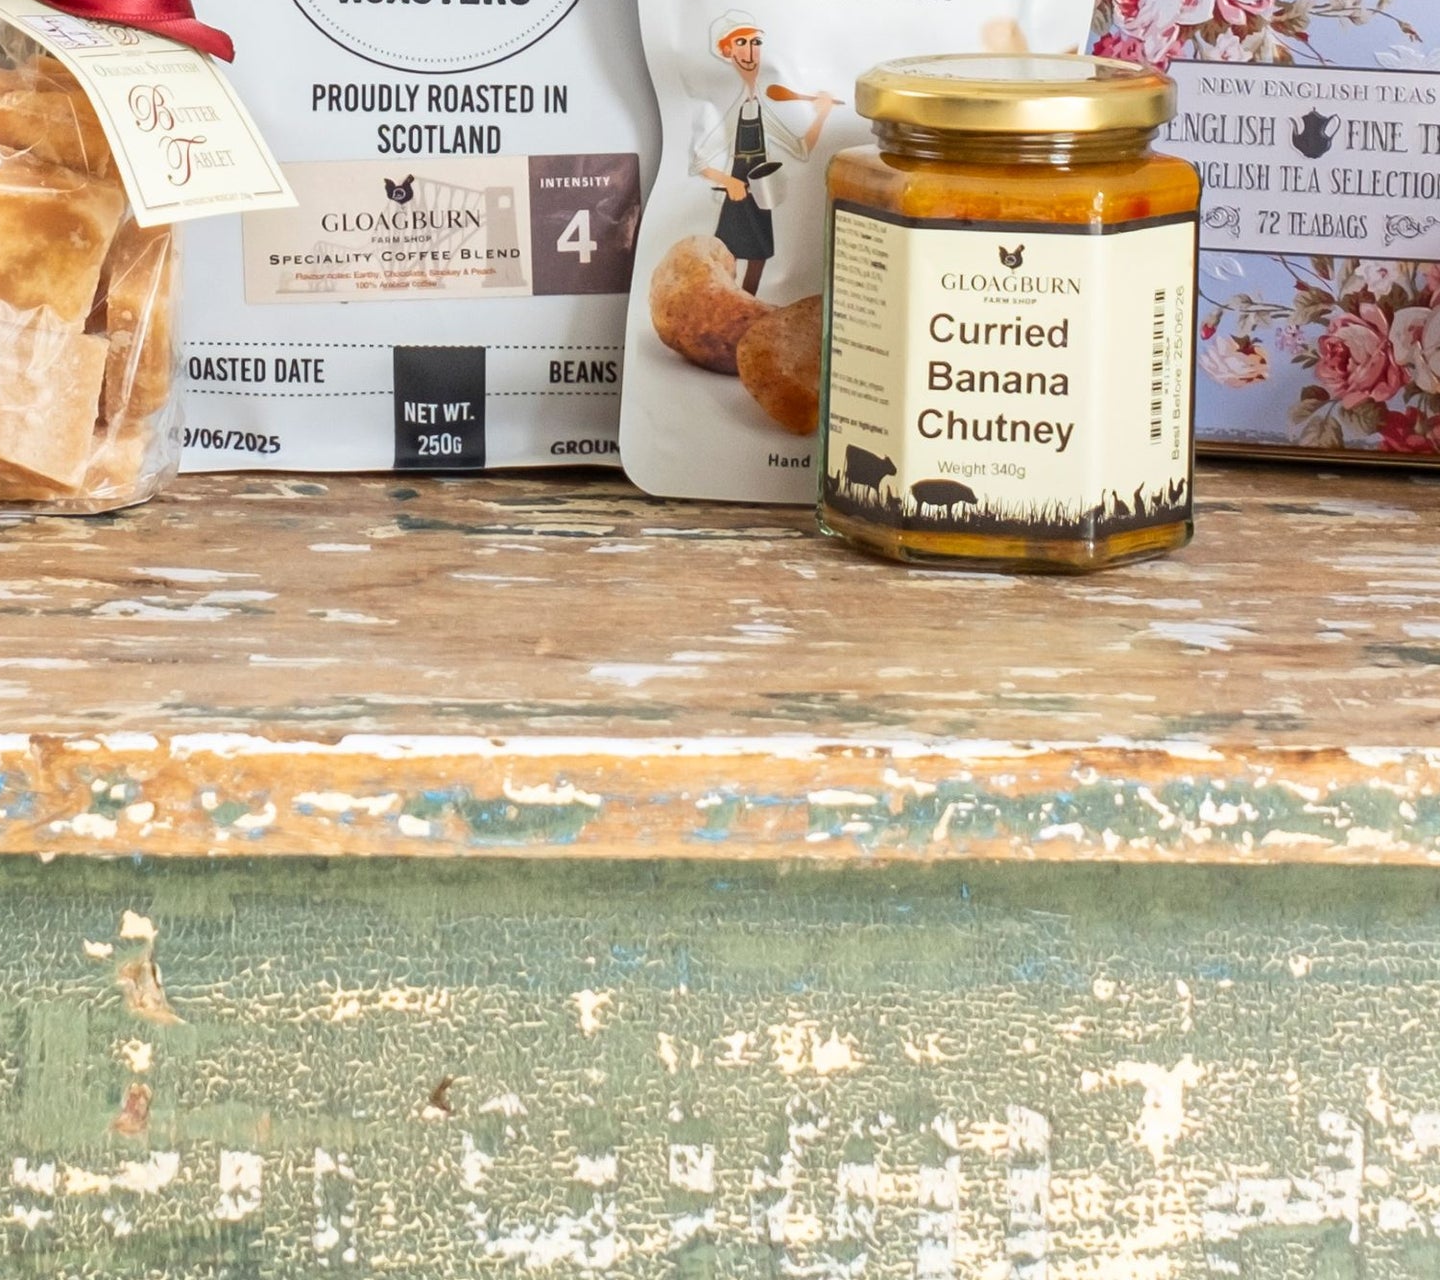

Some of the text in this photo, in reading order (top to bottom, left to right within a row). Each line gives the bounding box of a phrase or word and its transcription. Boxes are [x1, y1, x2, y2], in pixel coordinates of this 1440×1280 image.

[312, 83, 568, 114] PROUDLY ROASTED IN
[1199, 76, 1437, 105] NEW ENGLISH TEAS
[128, 85, 221, 132] BUTTER
[378, 124, 501, 154] SCOTLAND
[1345, 119, 1409, 153] FINE
[159, 135, 235, 186] TABLET
[540, 176, 610, 188] INTENSITY
[1195, 160, 1269, 191] NGLISH
[1280, 165, 1321, 193] TEA
[321, 210, 481, 233] GLOAGBURN
[1257, 210, 1368, 239] 72 TEABAGS
[556, 209, 598, 264] 4
[269, 248, 521, 266] SPECIALITY COFFEE BLEND
[941, 273, 1081, 295] GLOAGBURN
[929, 313, 1069, 348] Curried
[1173, 285, 1185, 359] 25/06/26
[188, 357, 325, 383] OASTED DATE
[549, 360, 617, 384] BEANS
[928, 360, 1069, 396] Banana
[404, 401, 475, 424] NET WT.
[418, 432, 462, 456] 250G
[917, 408, 1075, 453] Chutney
[937, 460, 1026, 479] Weight 340g
